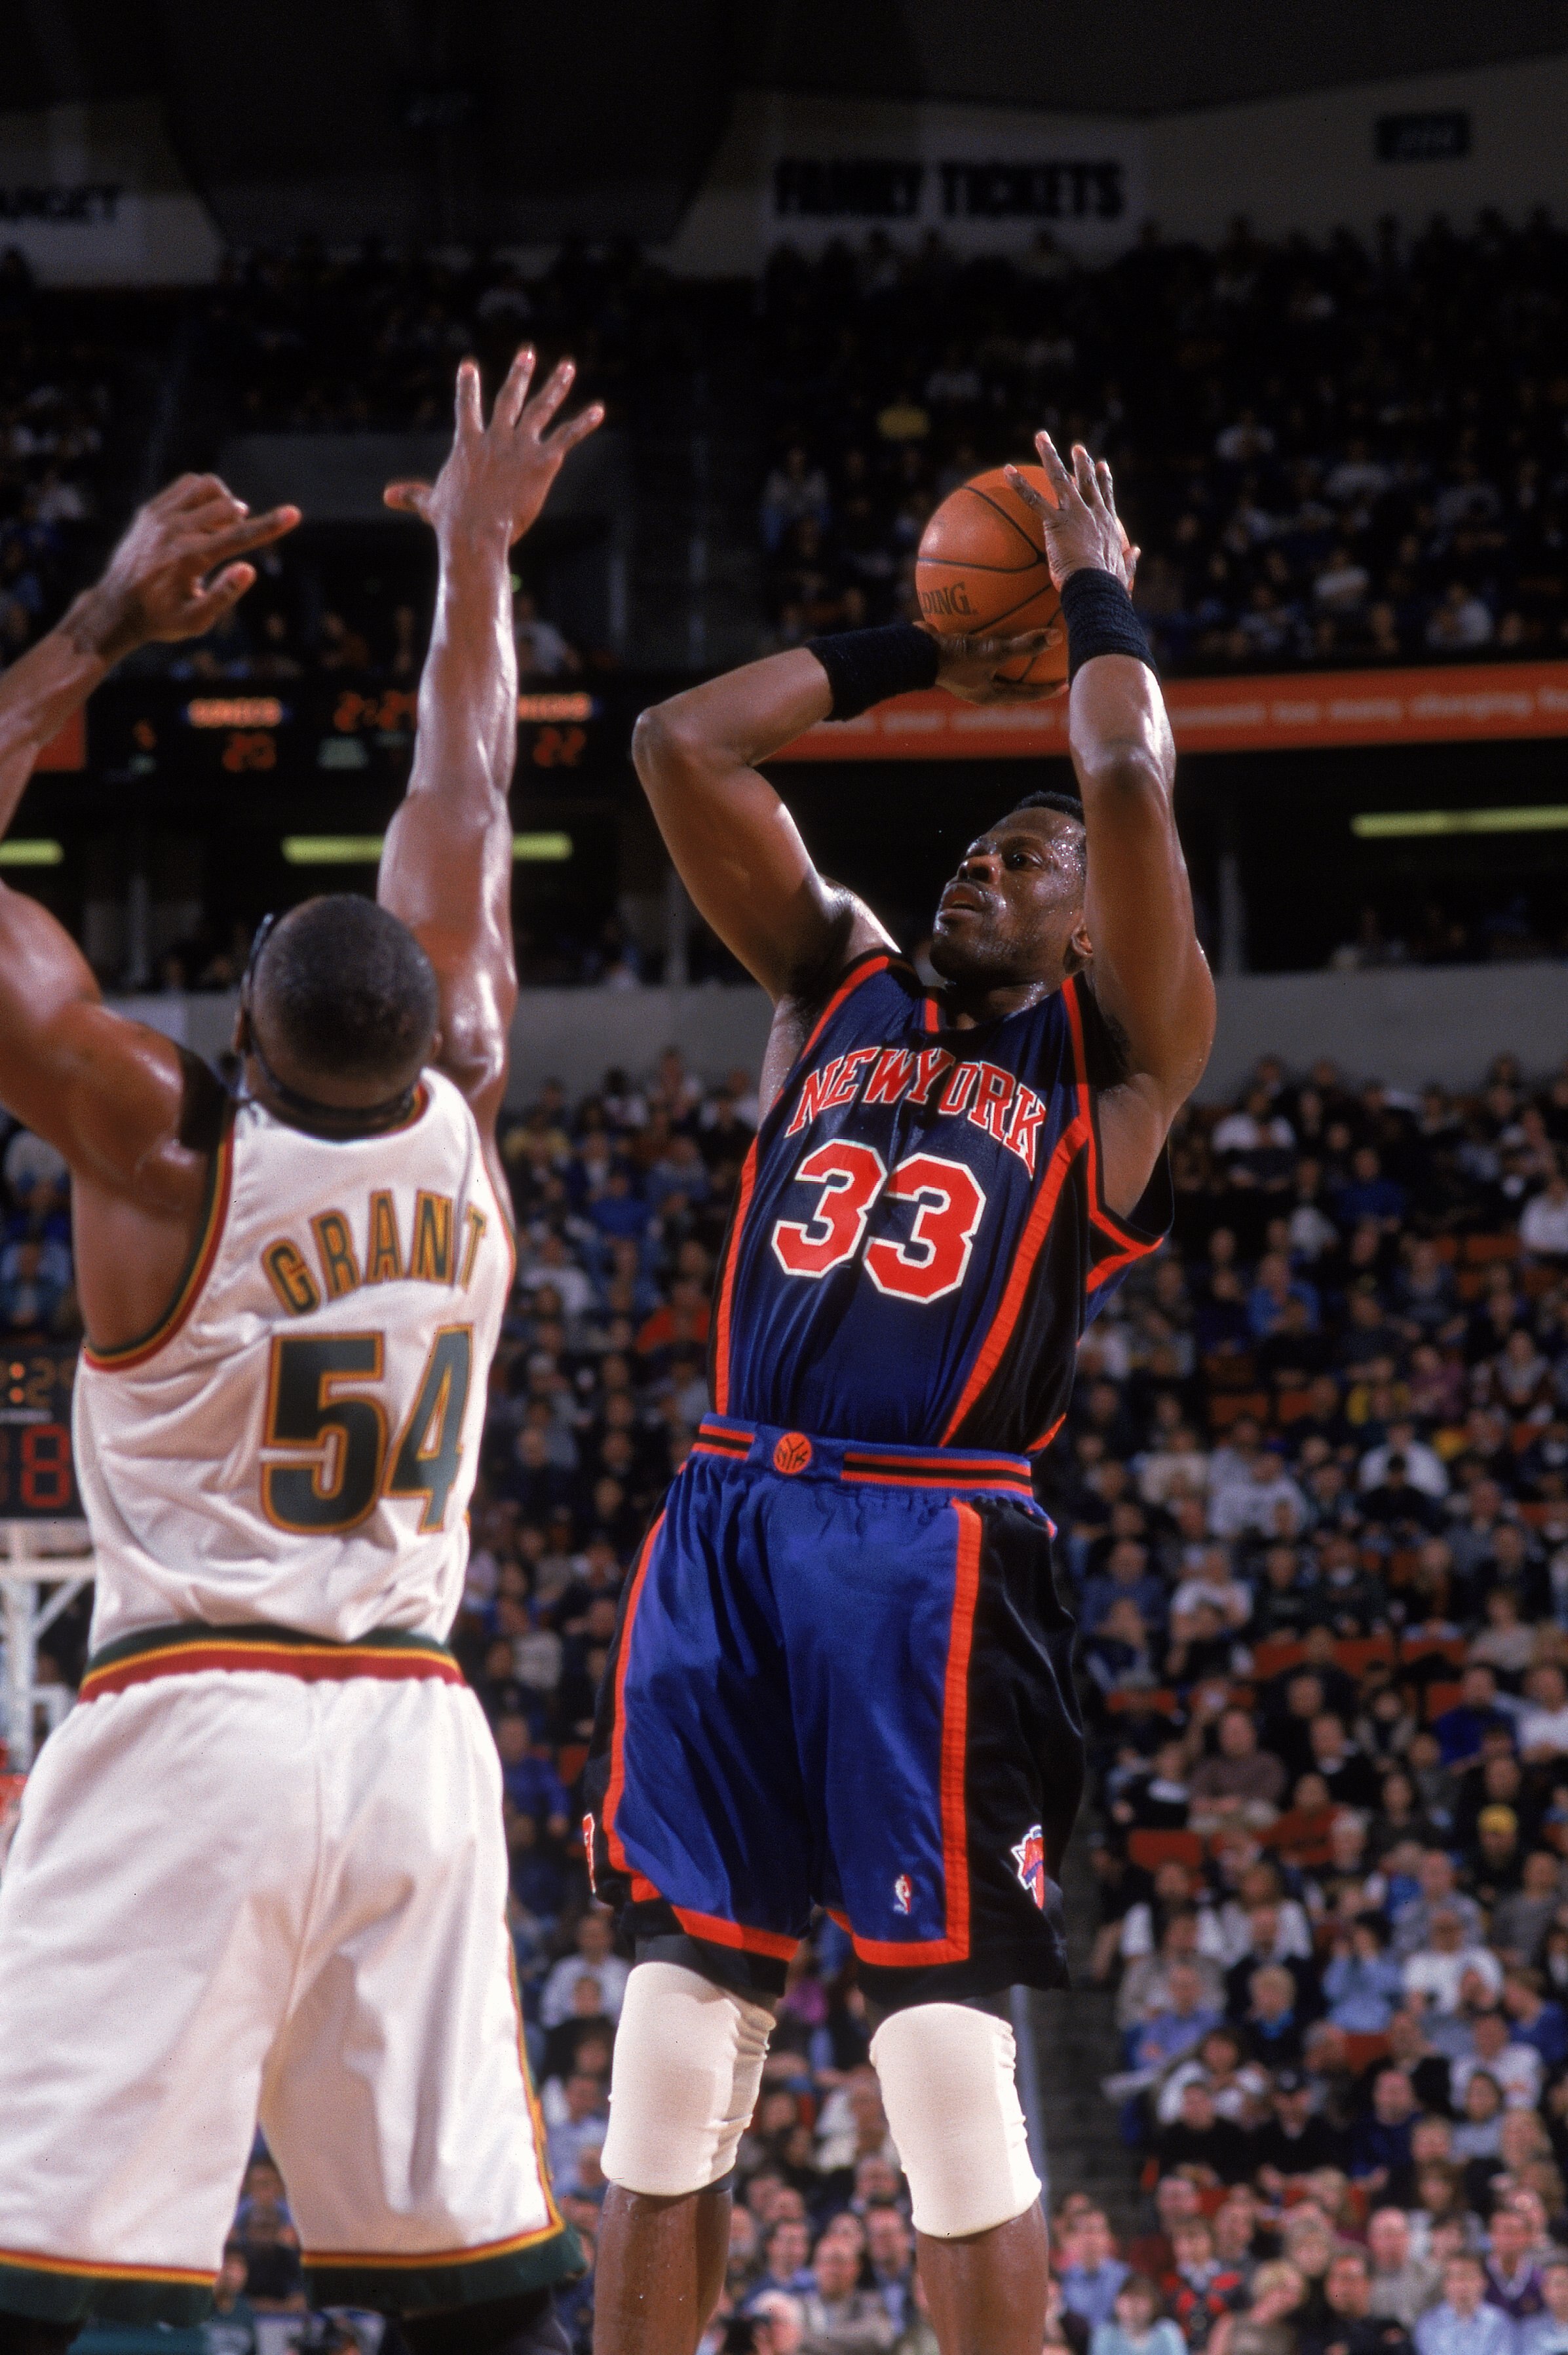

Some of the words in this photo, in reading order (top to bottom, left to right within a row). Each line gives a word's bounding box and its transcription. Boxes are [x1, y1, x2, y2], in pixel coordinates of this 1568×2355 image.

[919, 581, 971, 615] DING
[784, 1046, 919, 1139] NEW
[906, 1047, 1046, 1180] YORK
[259, 1188, 488, 1317] GRANT
[771, 1139, 987, 1304] 33
[260, 1323, 474, 1534] 54
